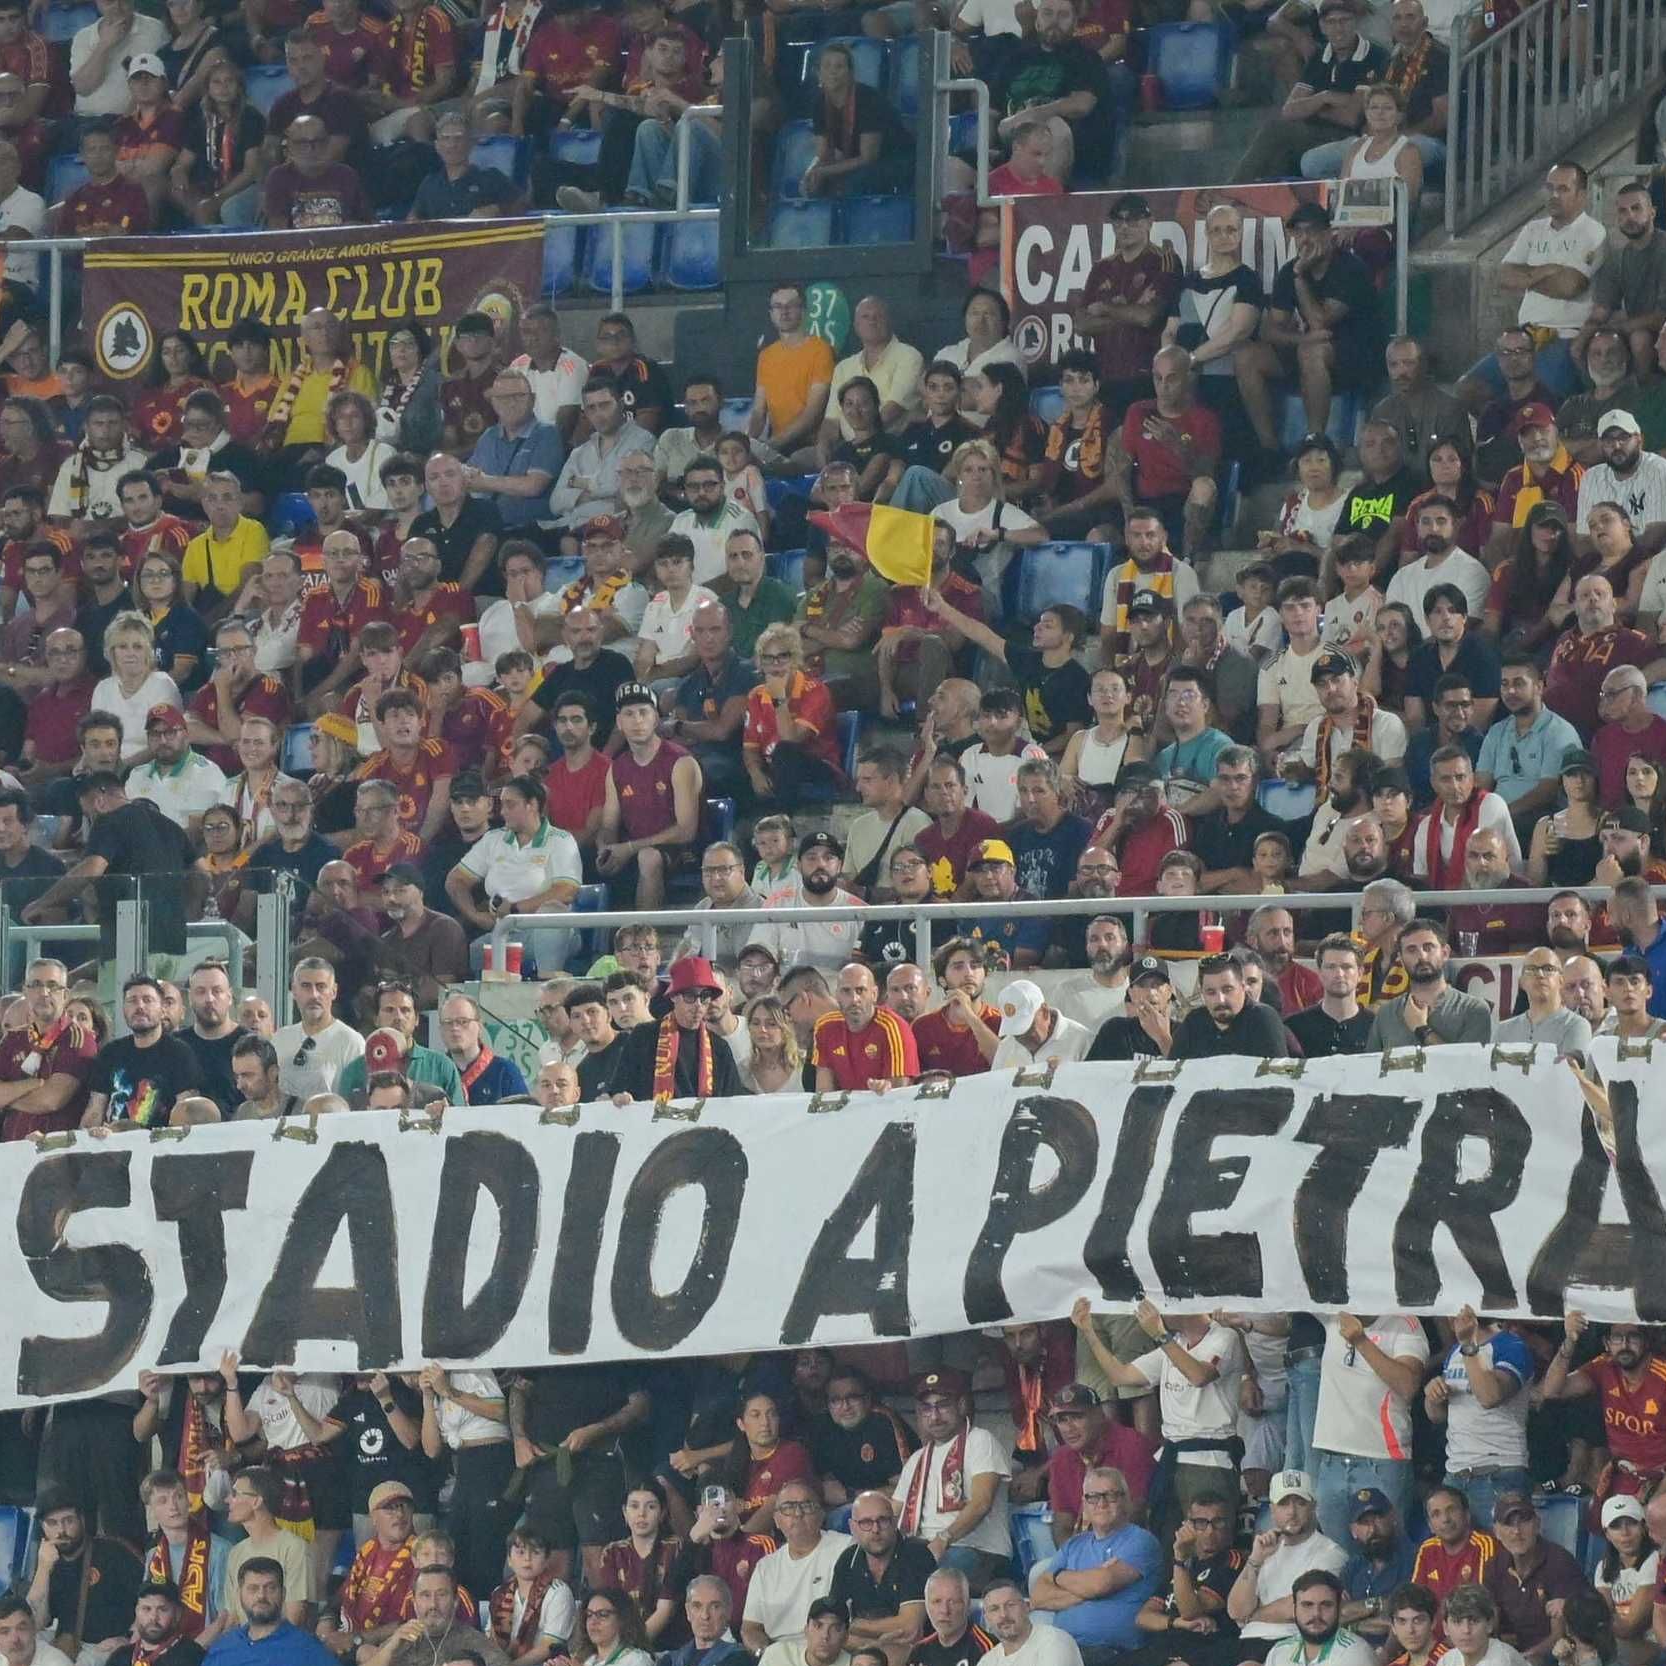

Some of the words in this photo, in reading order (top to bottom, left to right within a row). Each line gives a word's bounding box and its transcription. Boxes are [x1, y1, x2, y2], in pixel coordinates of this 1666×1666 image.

[230, 256, 273, 274] UNICO
[276, 250, 335, 270] GRANDE
[340, 242, 391, 264] AMORE
[181, 271, 308, 331] ROMA
[324, 257, 444, 321] CLUB
[810, 288, 837, 319] 37
[1350, 493, 1394, 525] ROMA
[15, 1126, 750, 1397] STADIO
[779, 1120, 917, 1346] A
